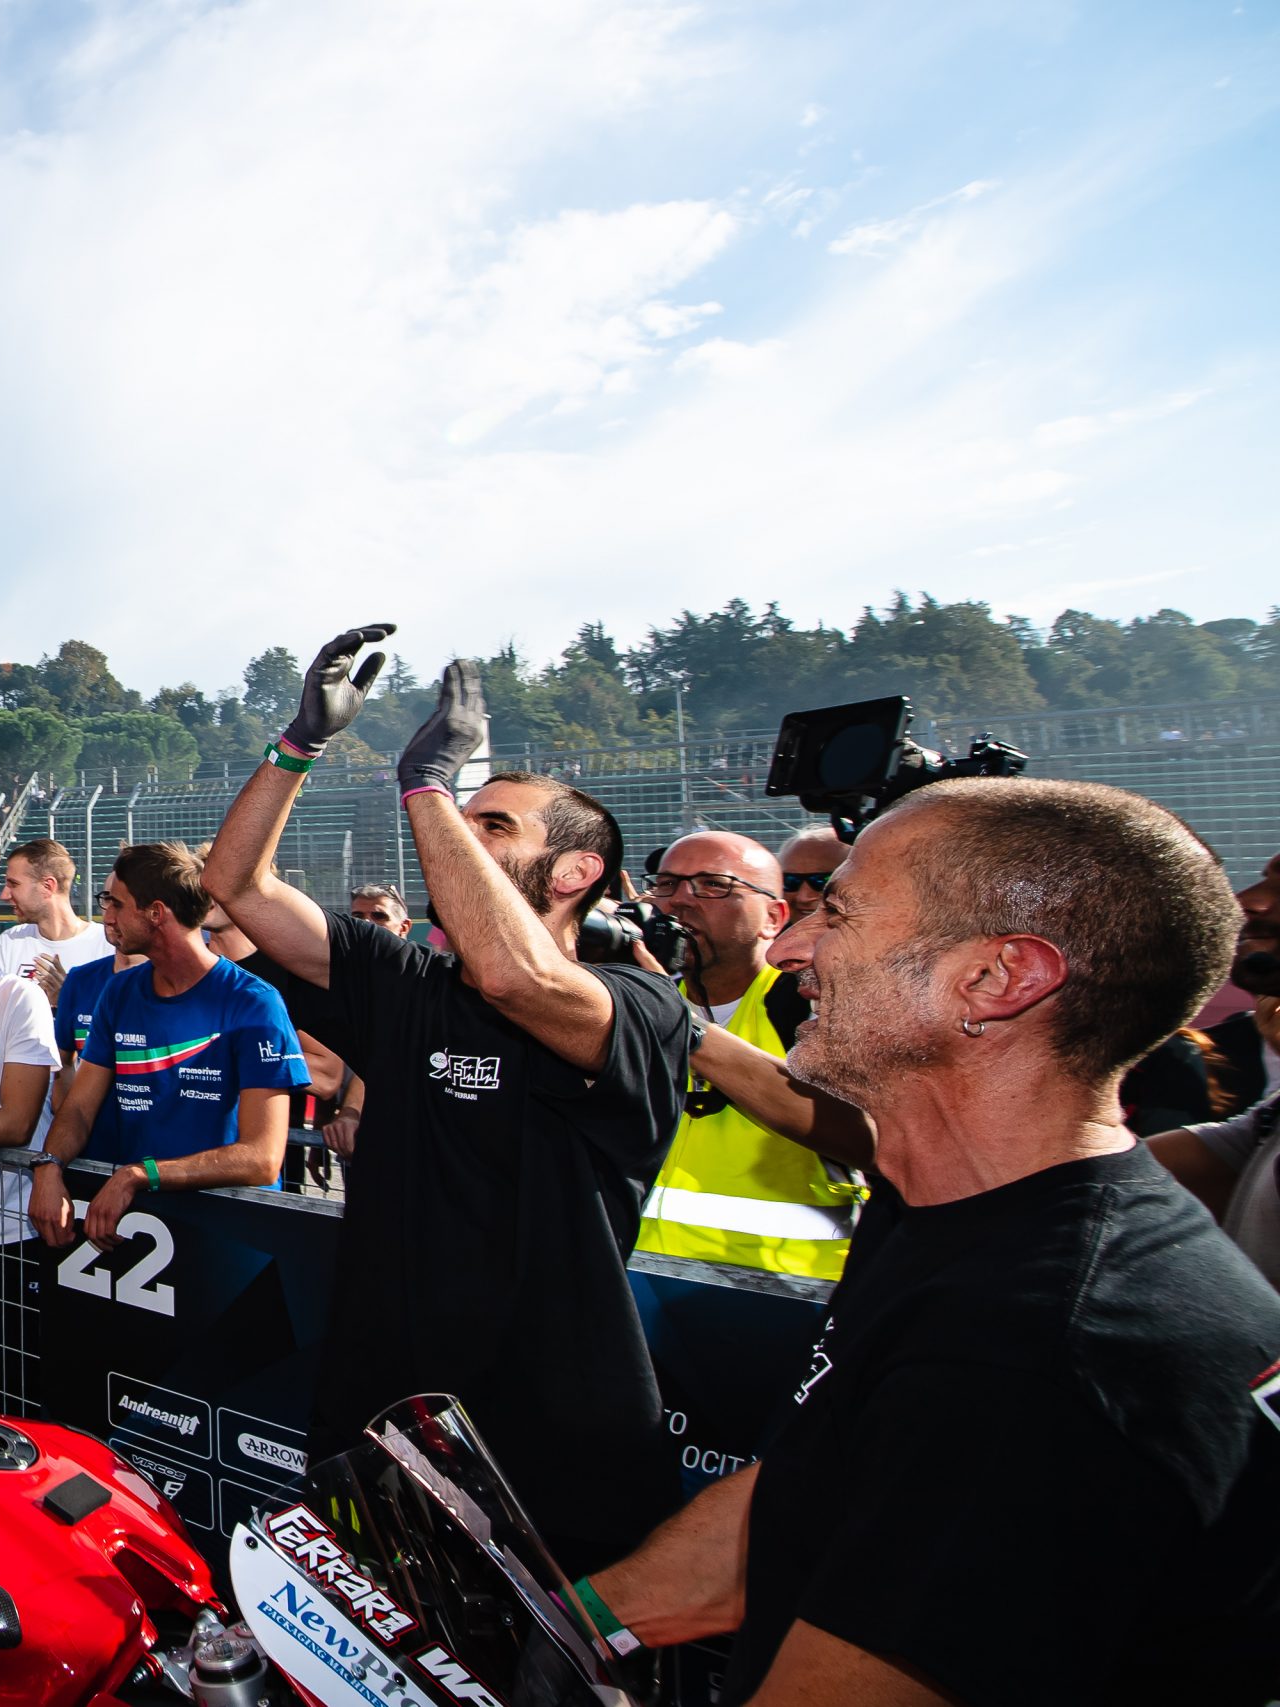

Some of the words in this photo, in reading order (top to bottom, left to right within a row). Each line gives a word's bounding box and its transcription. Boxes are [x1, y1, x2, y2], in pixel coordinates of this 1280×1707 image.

[118, 1394, 185, 1428] Andreani
[131, 1454, 187, 1482] VIRCOS
[245, 1437, 307, 1468] ARROW
[263, 1604, 327, 1660] PACKAGING
